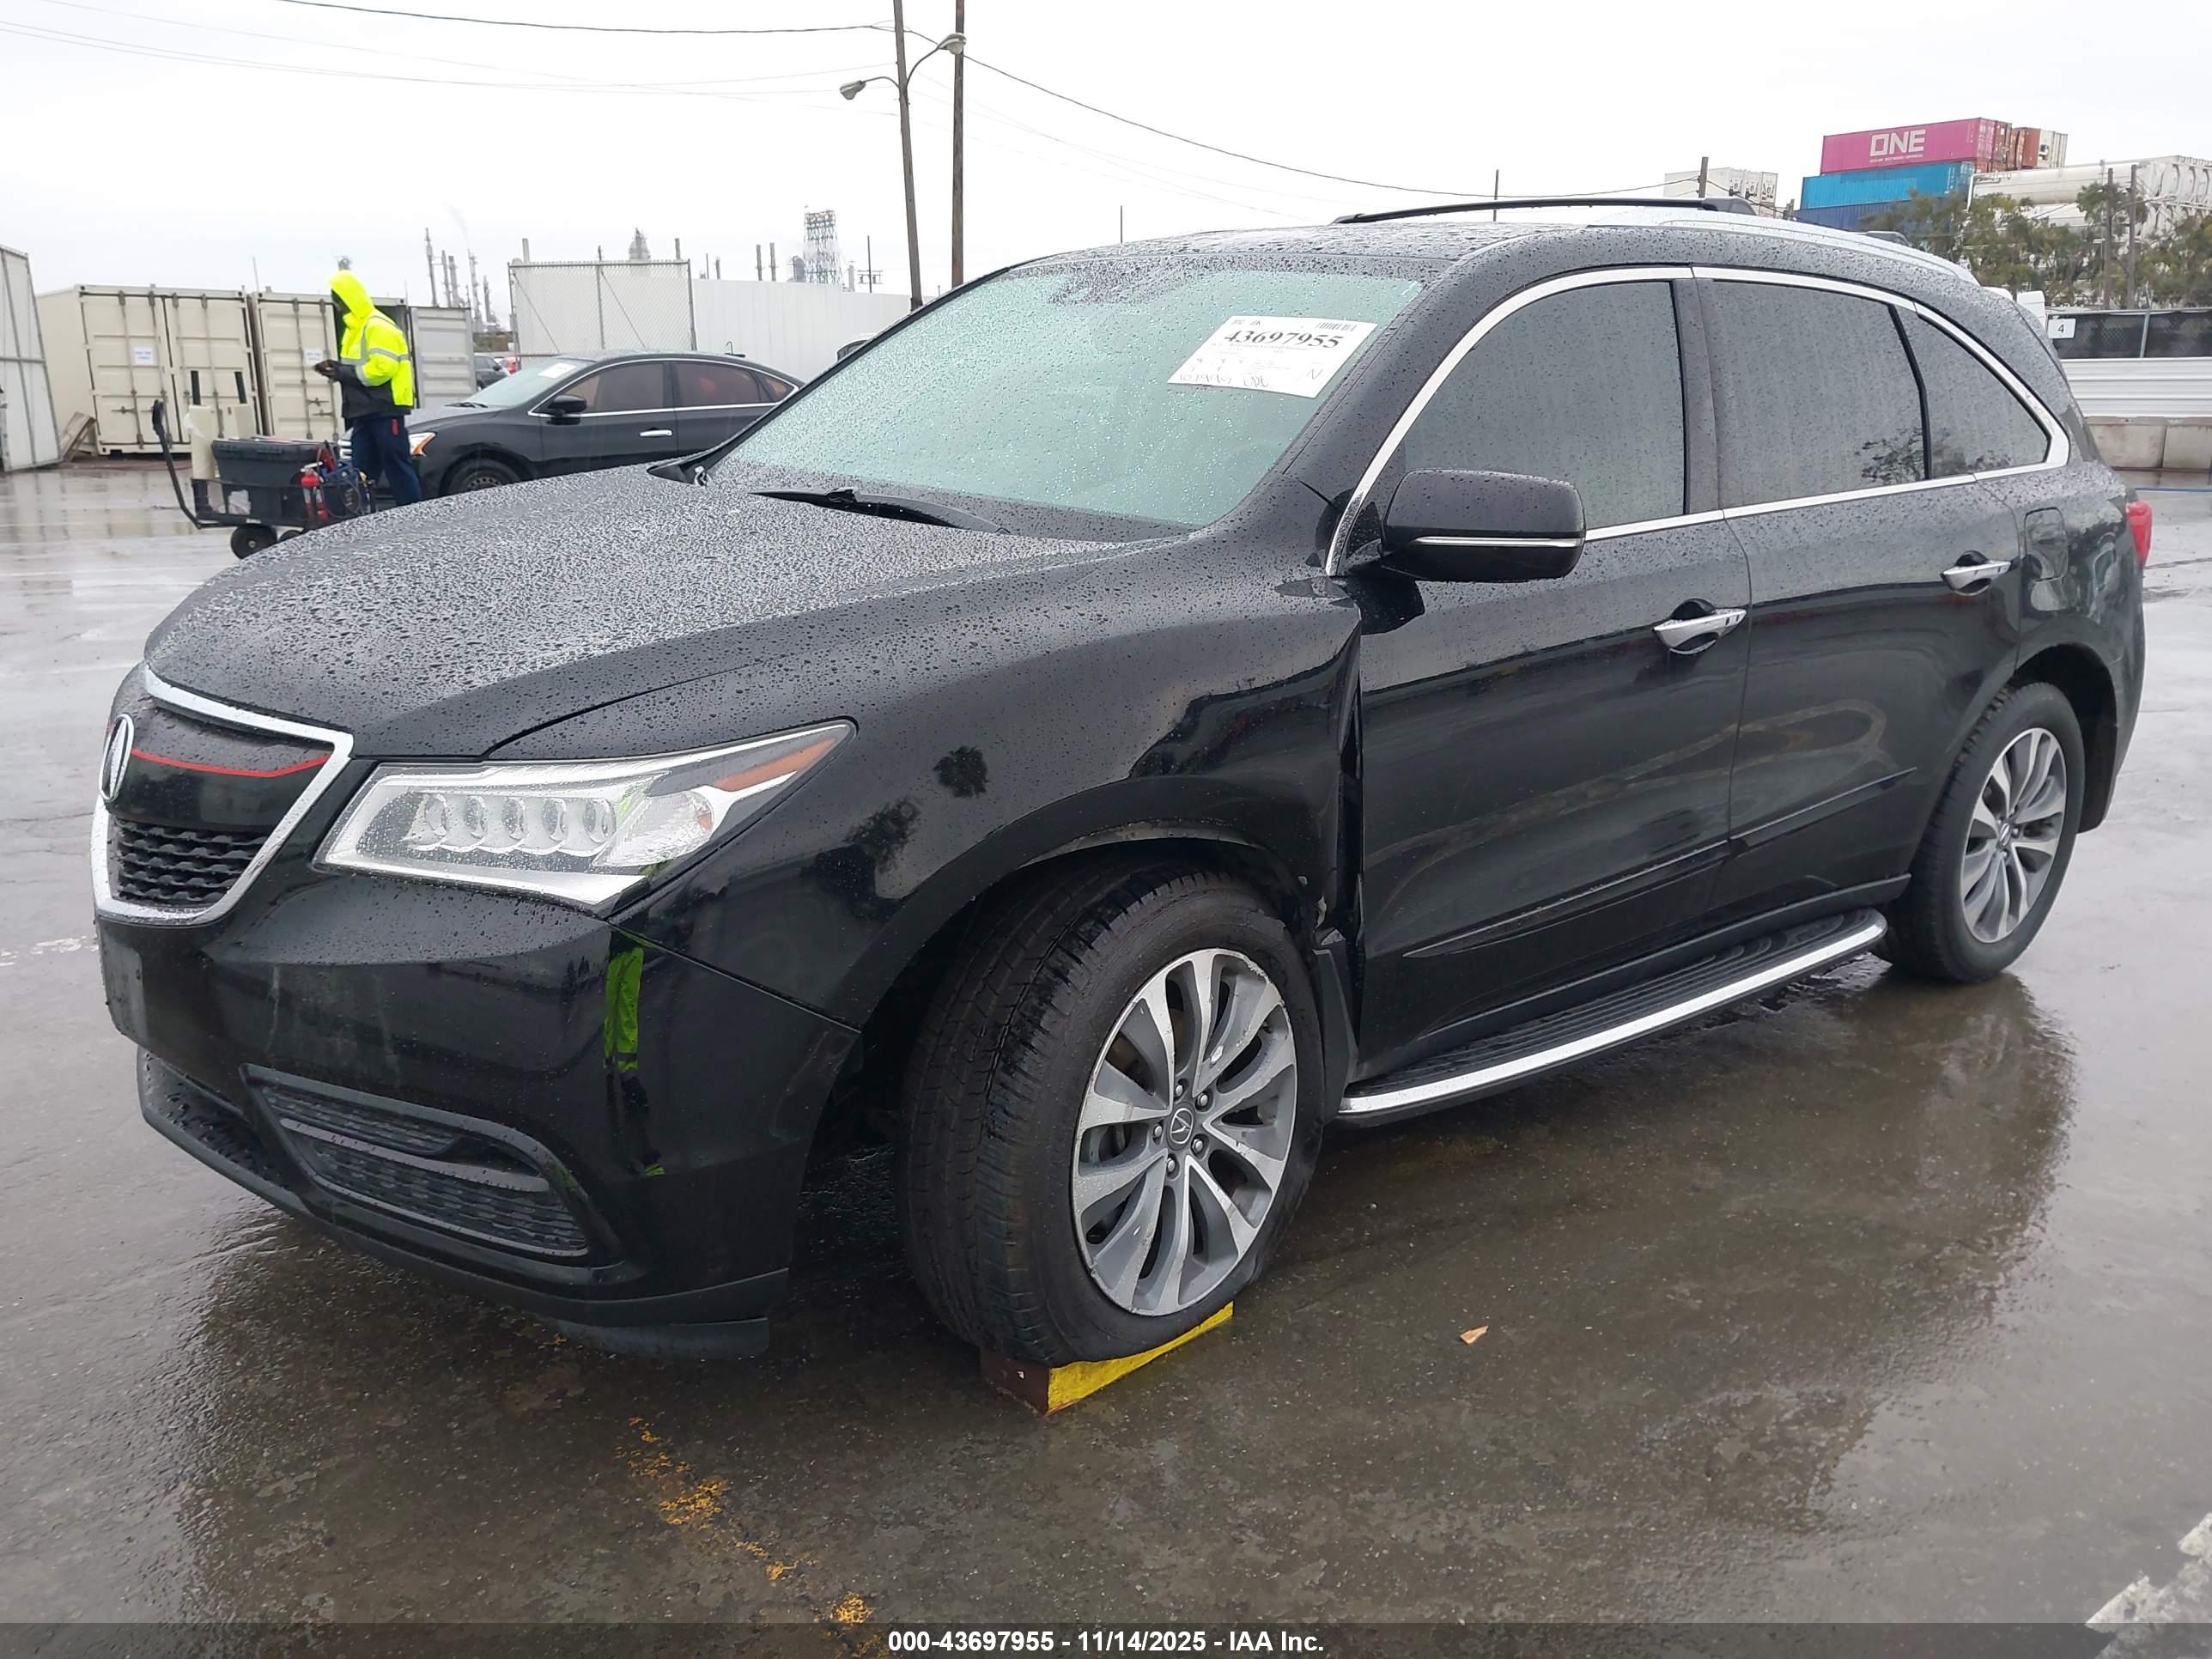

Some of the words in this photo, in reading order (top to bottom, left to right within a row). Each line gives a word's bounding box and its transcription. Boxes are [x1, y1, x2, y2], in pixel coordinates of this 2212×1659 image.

[1870, 130, 1926, 156] ONE
[2057, 324, 2064, 333] 4
[1224, 331, 1344, 349] 43697955
